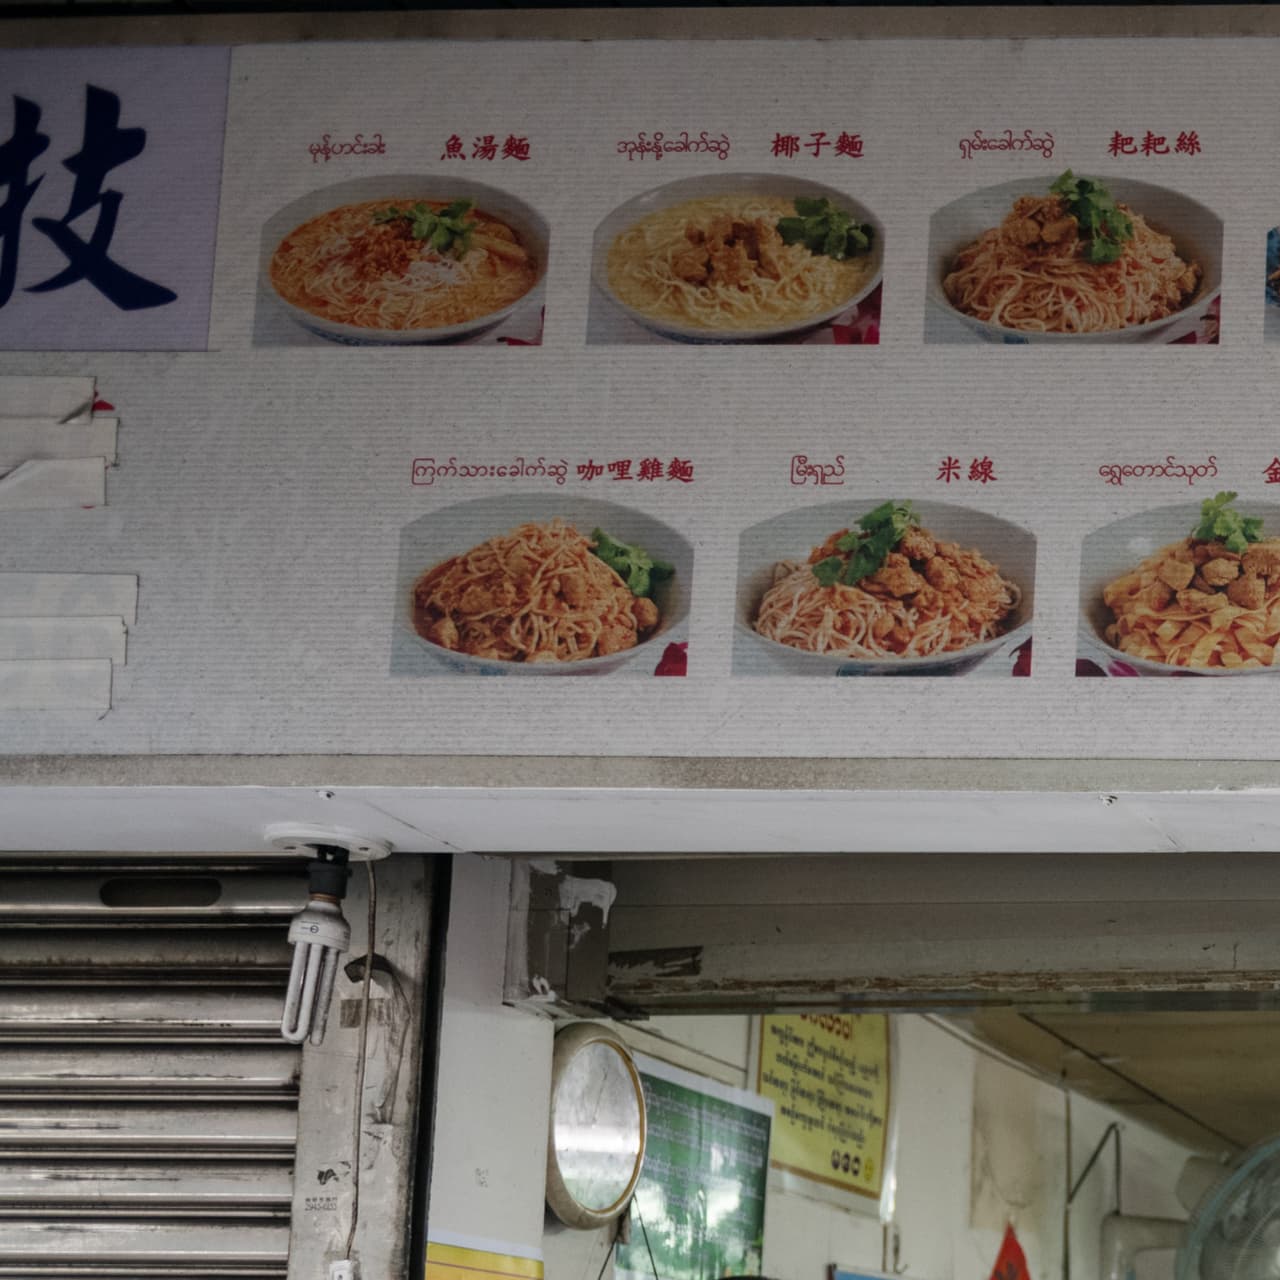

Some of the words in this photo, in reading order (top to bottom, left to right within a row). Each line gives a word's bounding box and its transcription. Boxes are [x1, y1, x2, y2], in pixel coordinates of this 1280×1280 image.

[440, 133, 532, 162] 魚湯麵
[770, 131, 866, 160] 椰子麵
[576, 458, 696, 485] 咖哩雞麵
[936, 456, 999, 485] 米線
